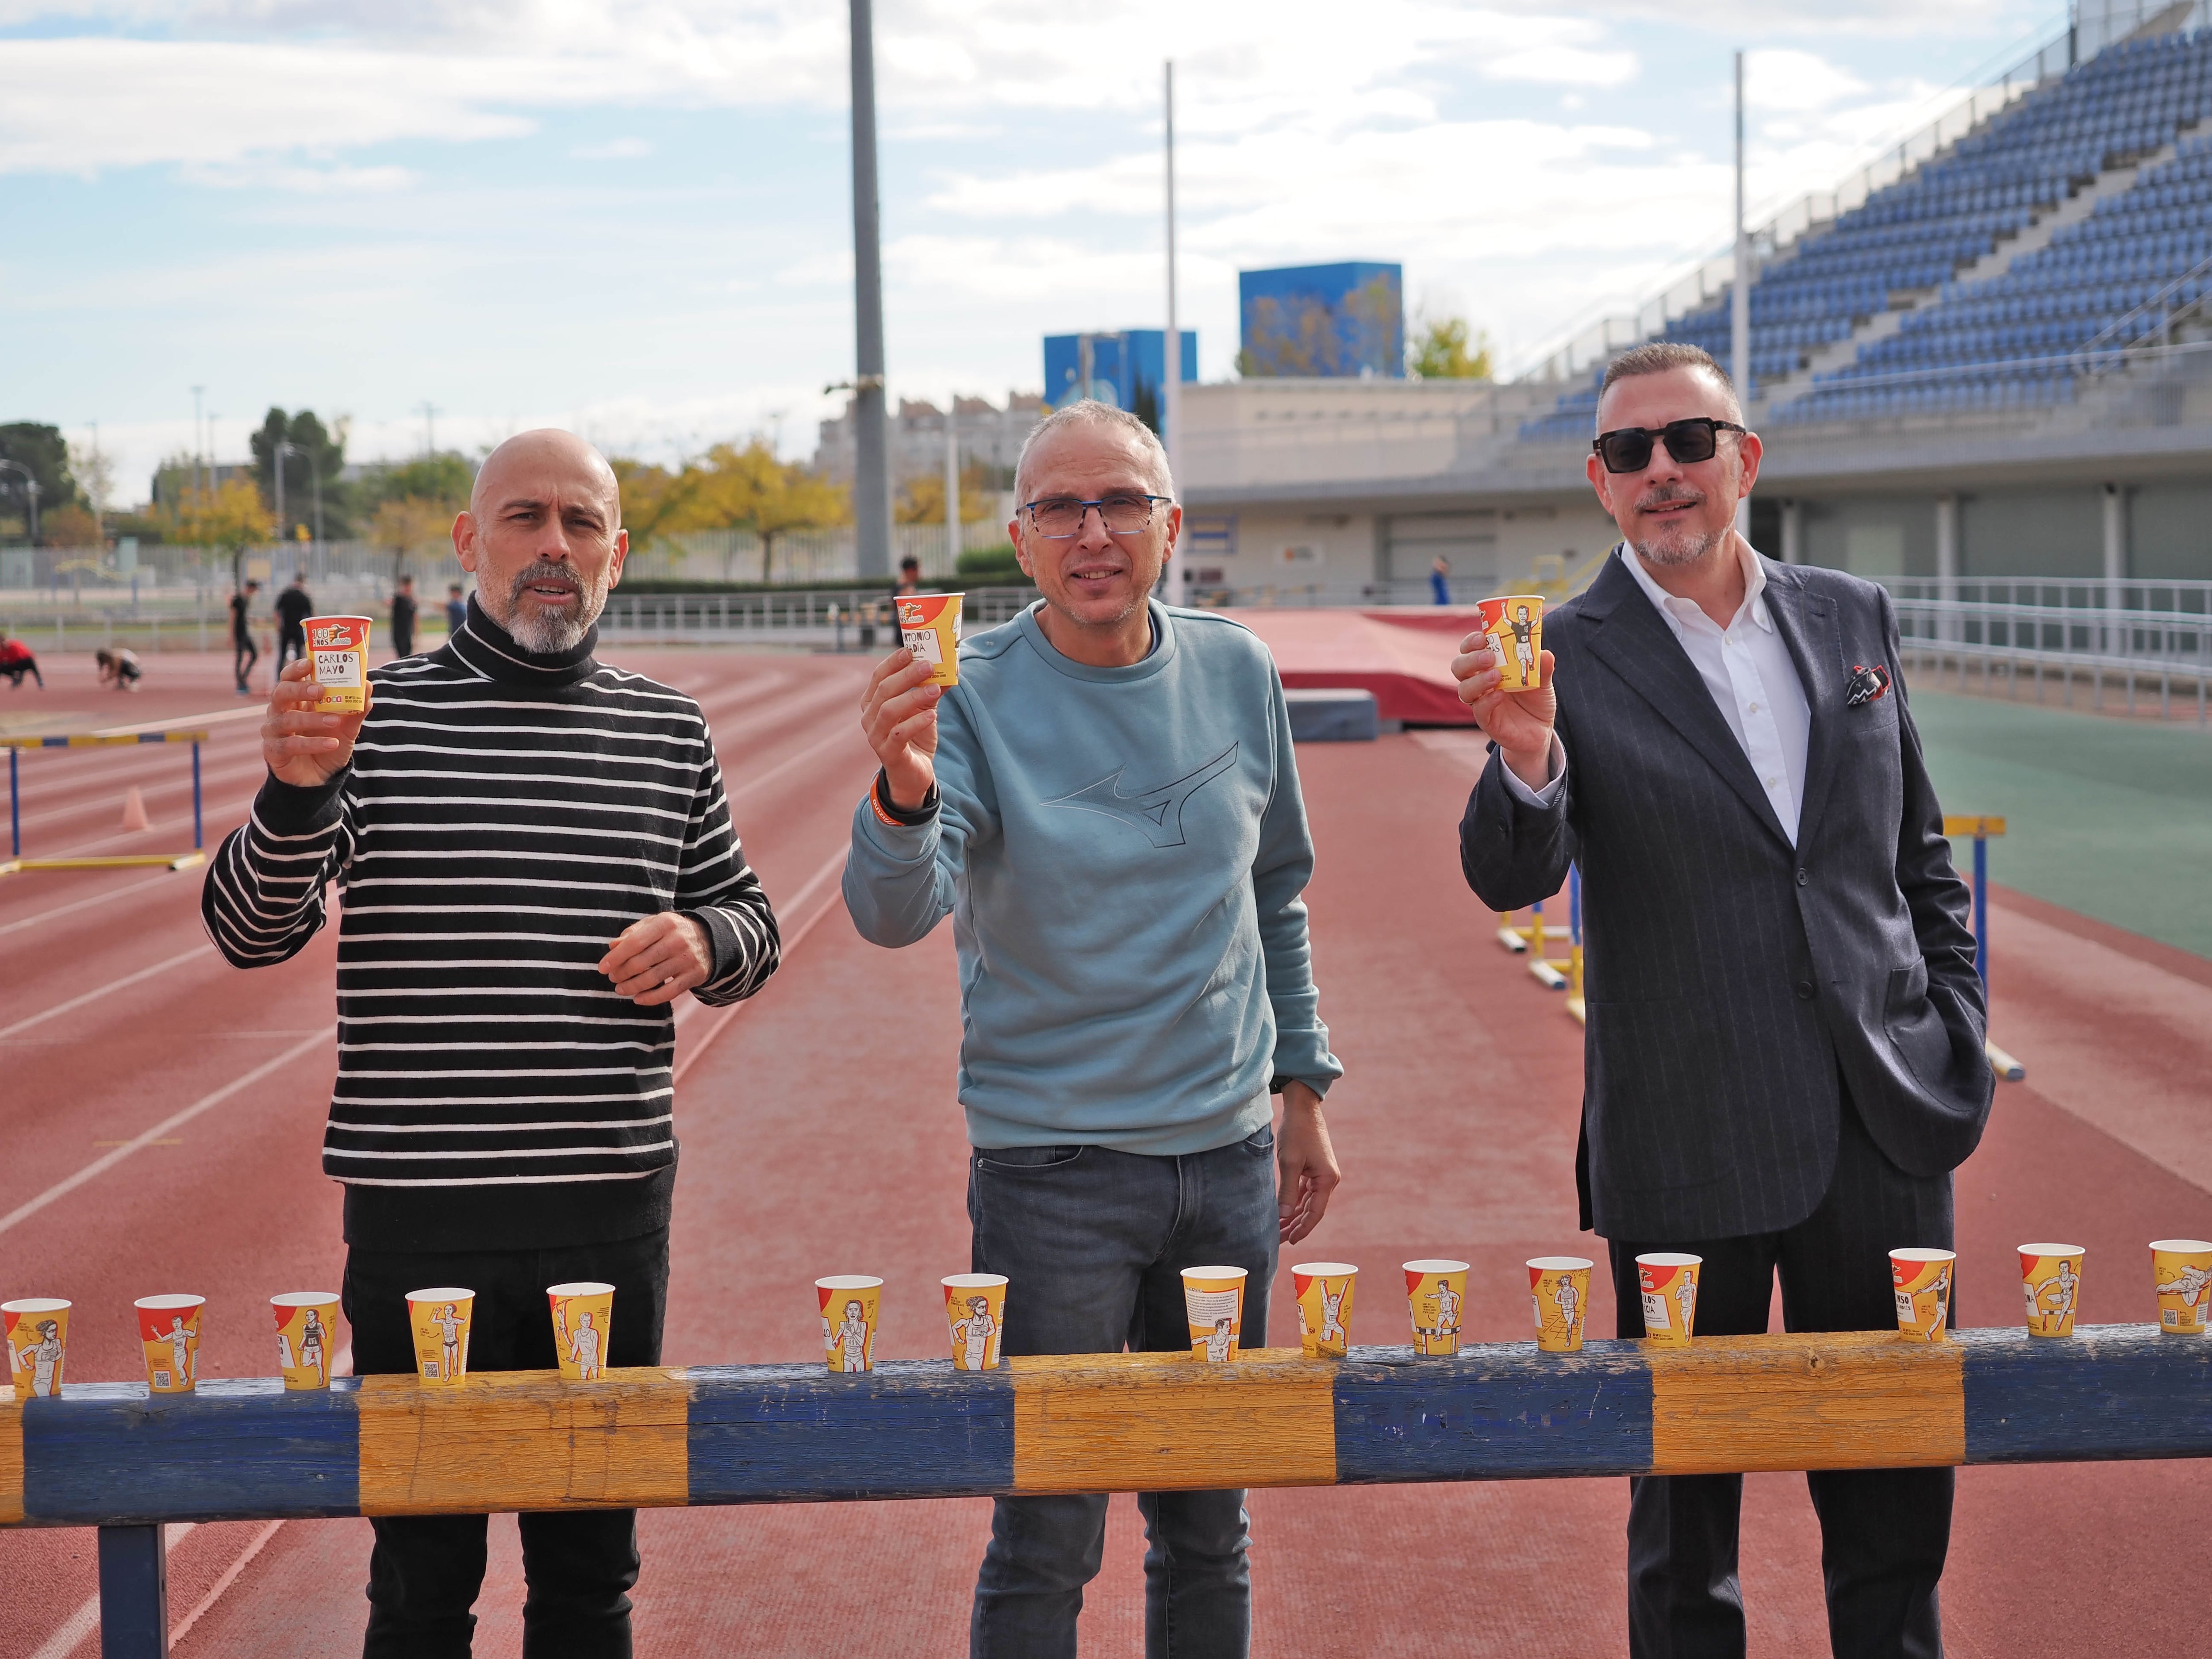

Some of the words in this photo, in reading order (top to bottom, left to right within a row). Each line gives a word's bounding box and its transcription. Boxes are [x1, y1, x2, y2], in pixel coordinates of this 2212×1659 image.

[312, 629, 328, 639] 100
[319, 653, 353, 664] CARLOS
[319, 665, 344, 675] MAYO
[1896, 1294, 1909, 1304] NSO
